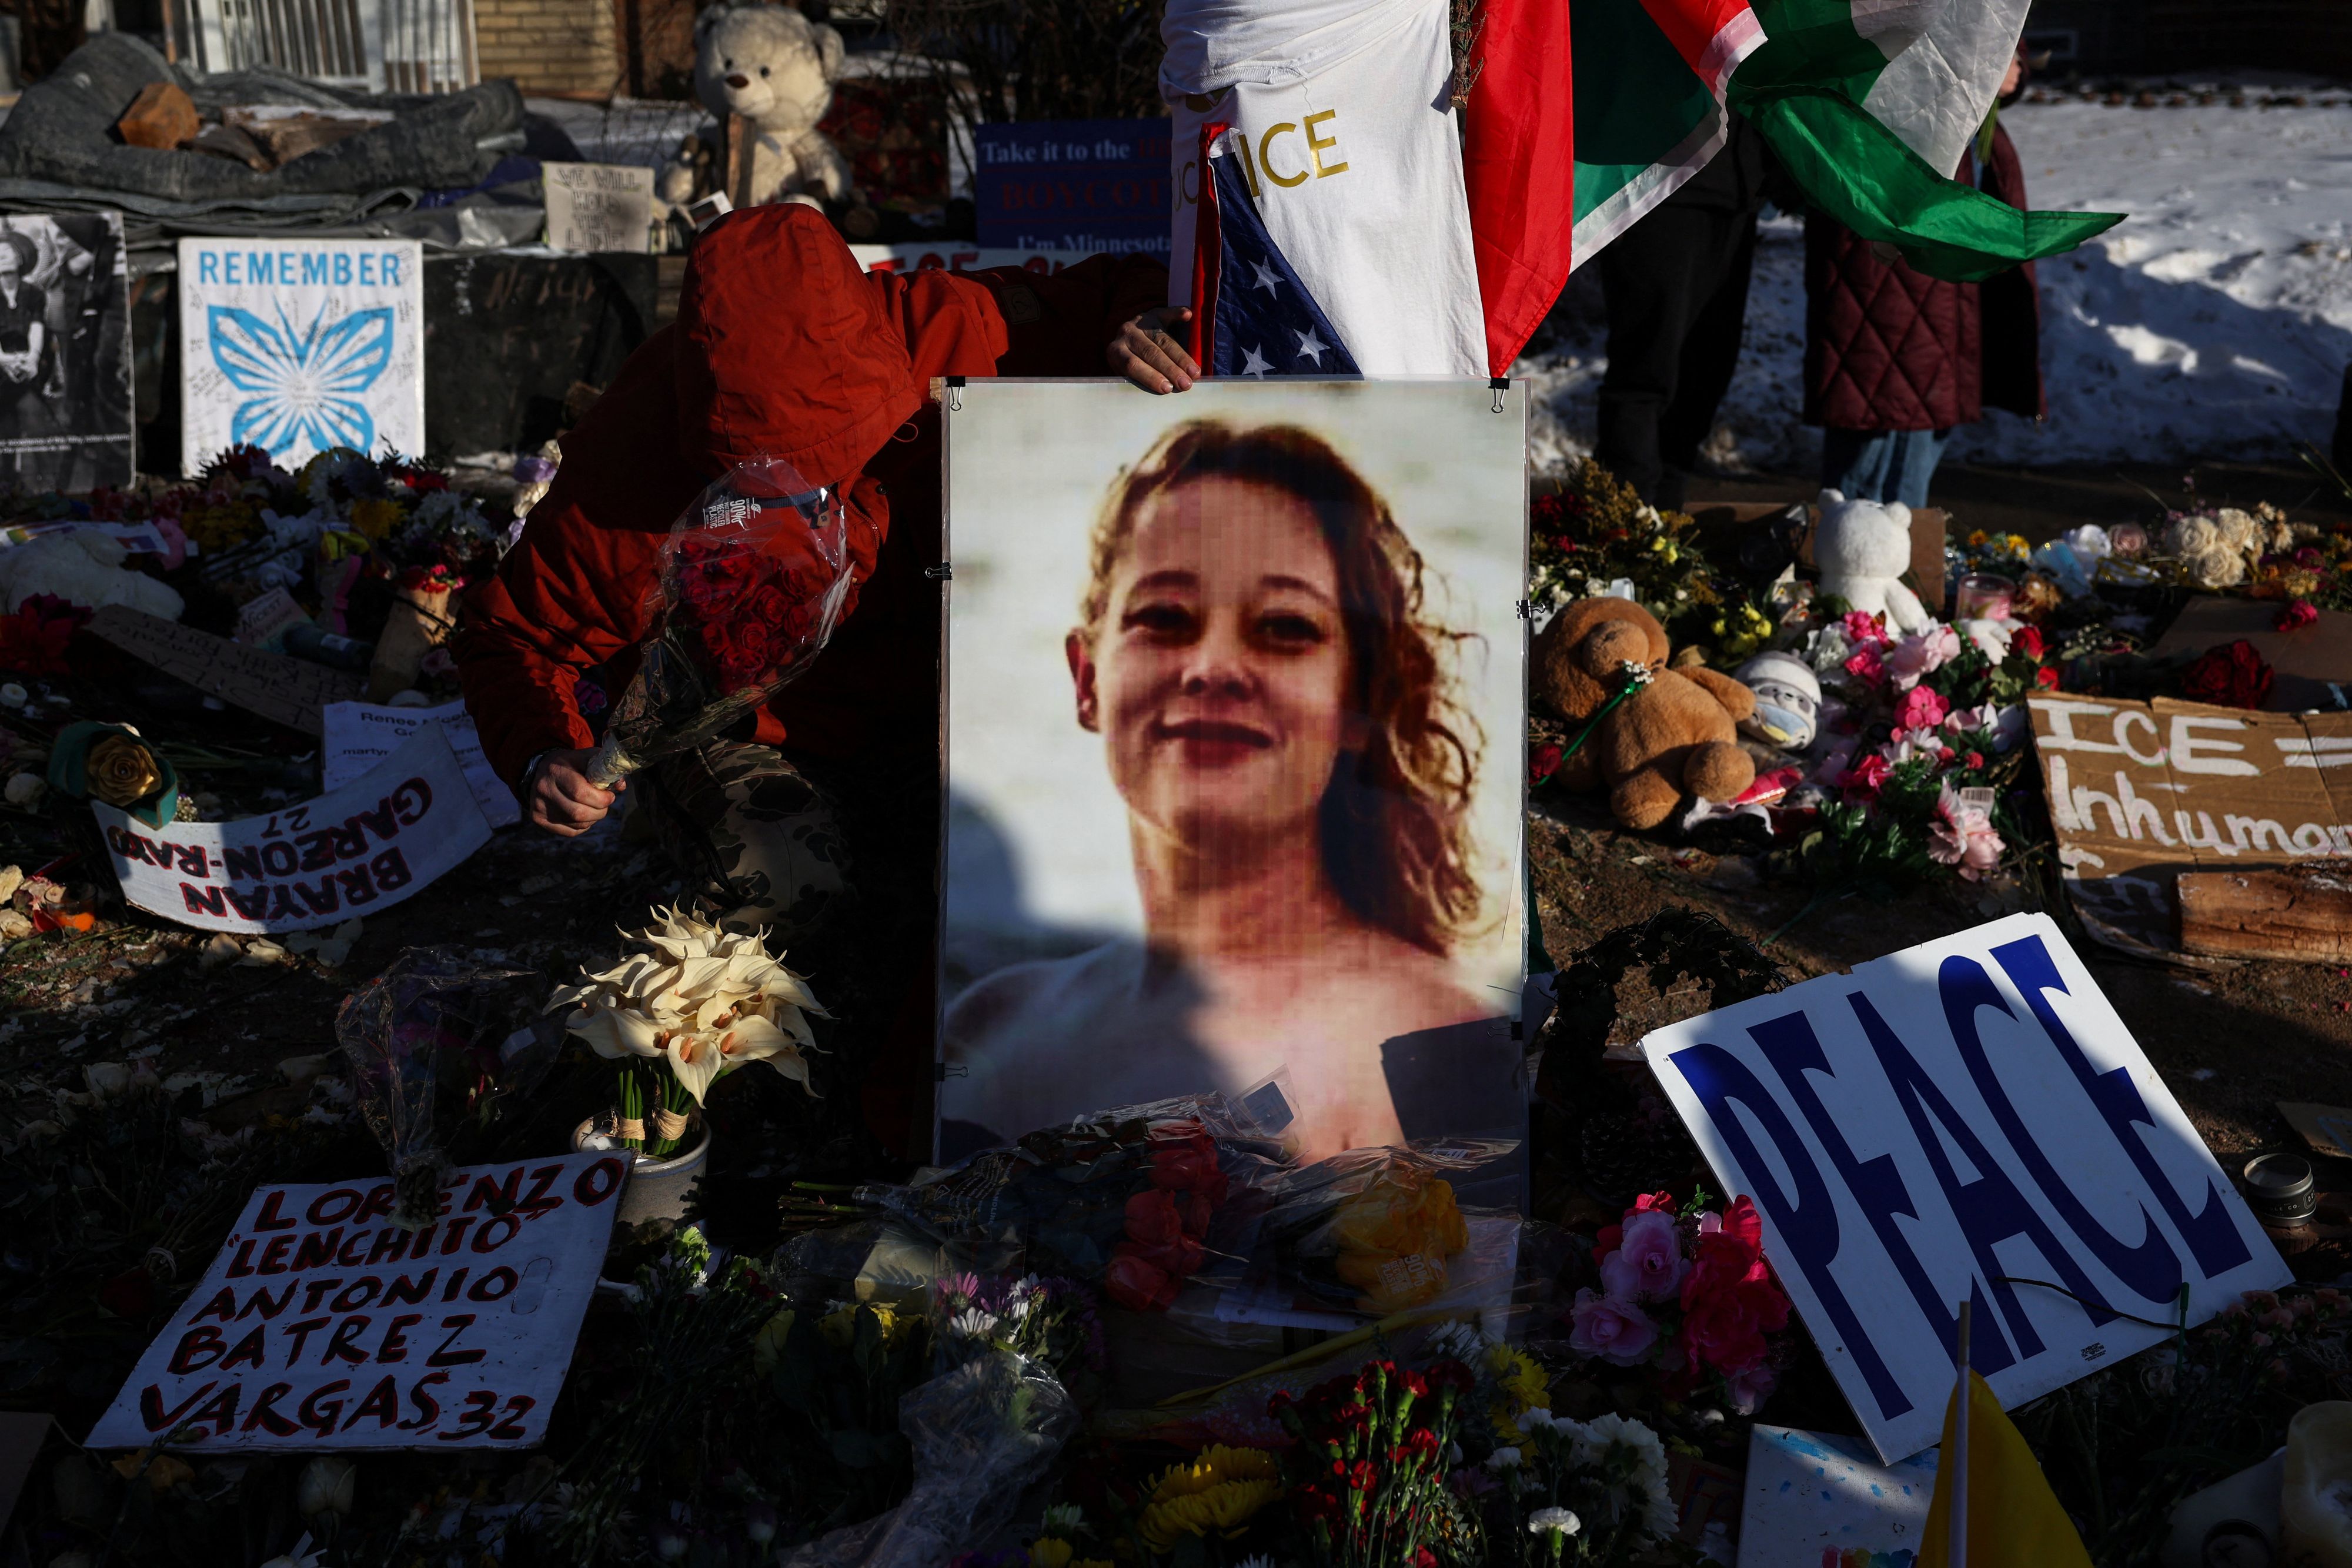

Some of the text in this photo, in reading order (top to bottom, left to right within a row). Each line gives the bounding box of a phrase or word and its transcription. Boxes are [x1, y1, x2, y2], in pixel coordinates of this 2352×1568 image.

[980, 139, 1037, 164] Take
[1043, 139, 1059, 162] it
[1065, 141, 1088, 161] to
[1094, 138, 1131, 161] the
[1238, 109, 1349, 197] ICE
[1001, 179, 1171, 211] BOYCOT
[1063, 233, 1172, 253] Minnesot
[200, 252, 400, 286] REMEMBER
[709, 506, 718, 529] PLASTIC
[716, 503, 726, 527] RECYCLED
[730, 499, 747, 524] 90%
[361, 712, 417, 726] Renee
[2027, 698, 2261, 777] ICE
[260, 807, 310, 838] 27
[179, 845, 412, 921] BRAYAN
[253, 1158, 624, 1232] LORENZO
[1668, 934, 2253, 1422] PEACE
[188, 1266, 518, 1326] ANTONIO
[167, 1314, 486, 1375] BATREZ
[438, 1389, 536, 1440] 32
